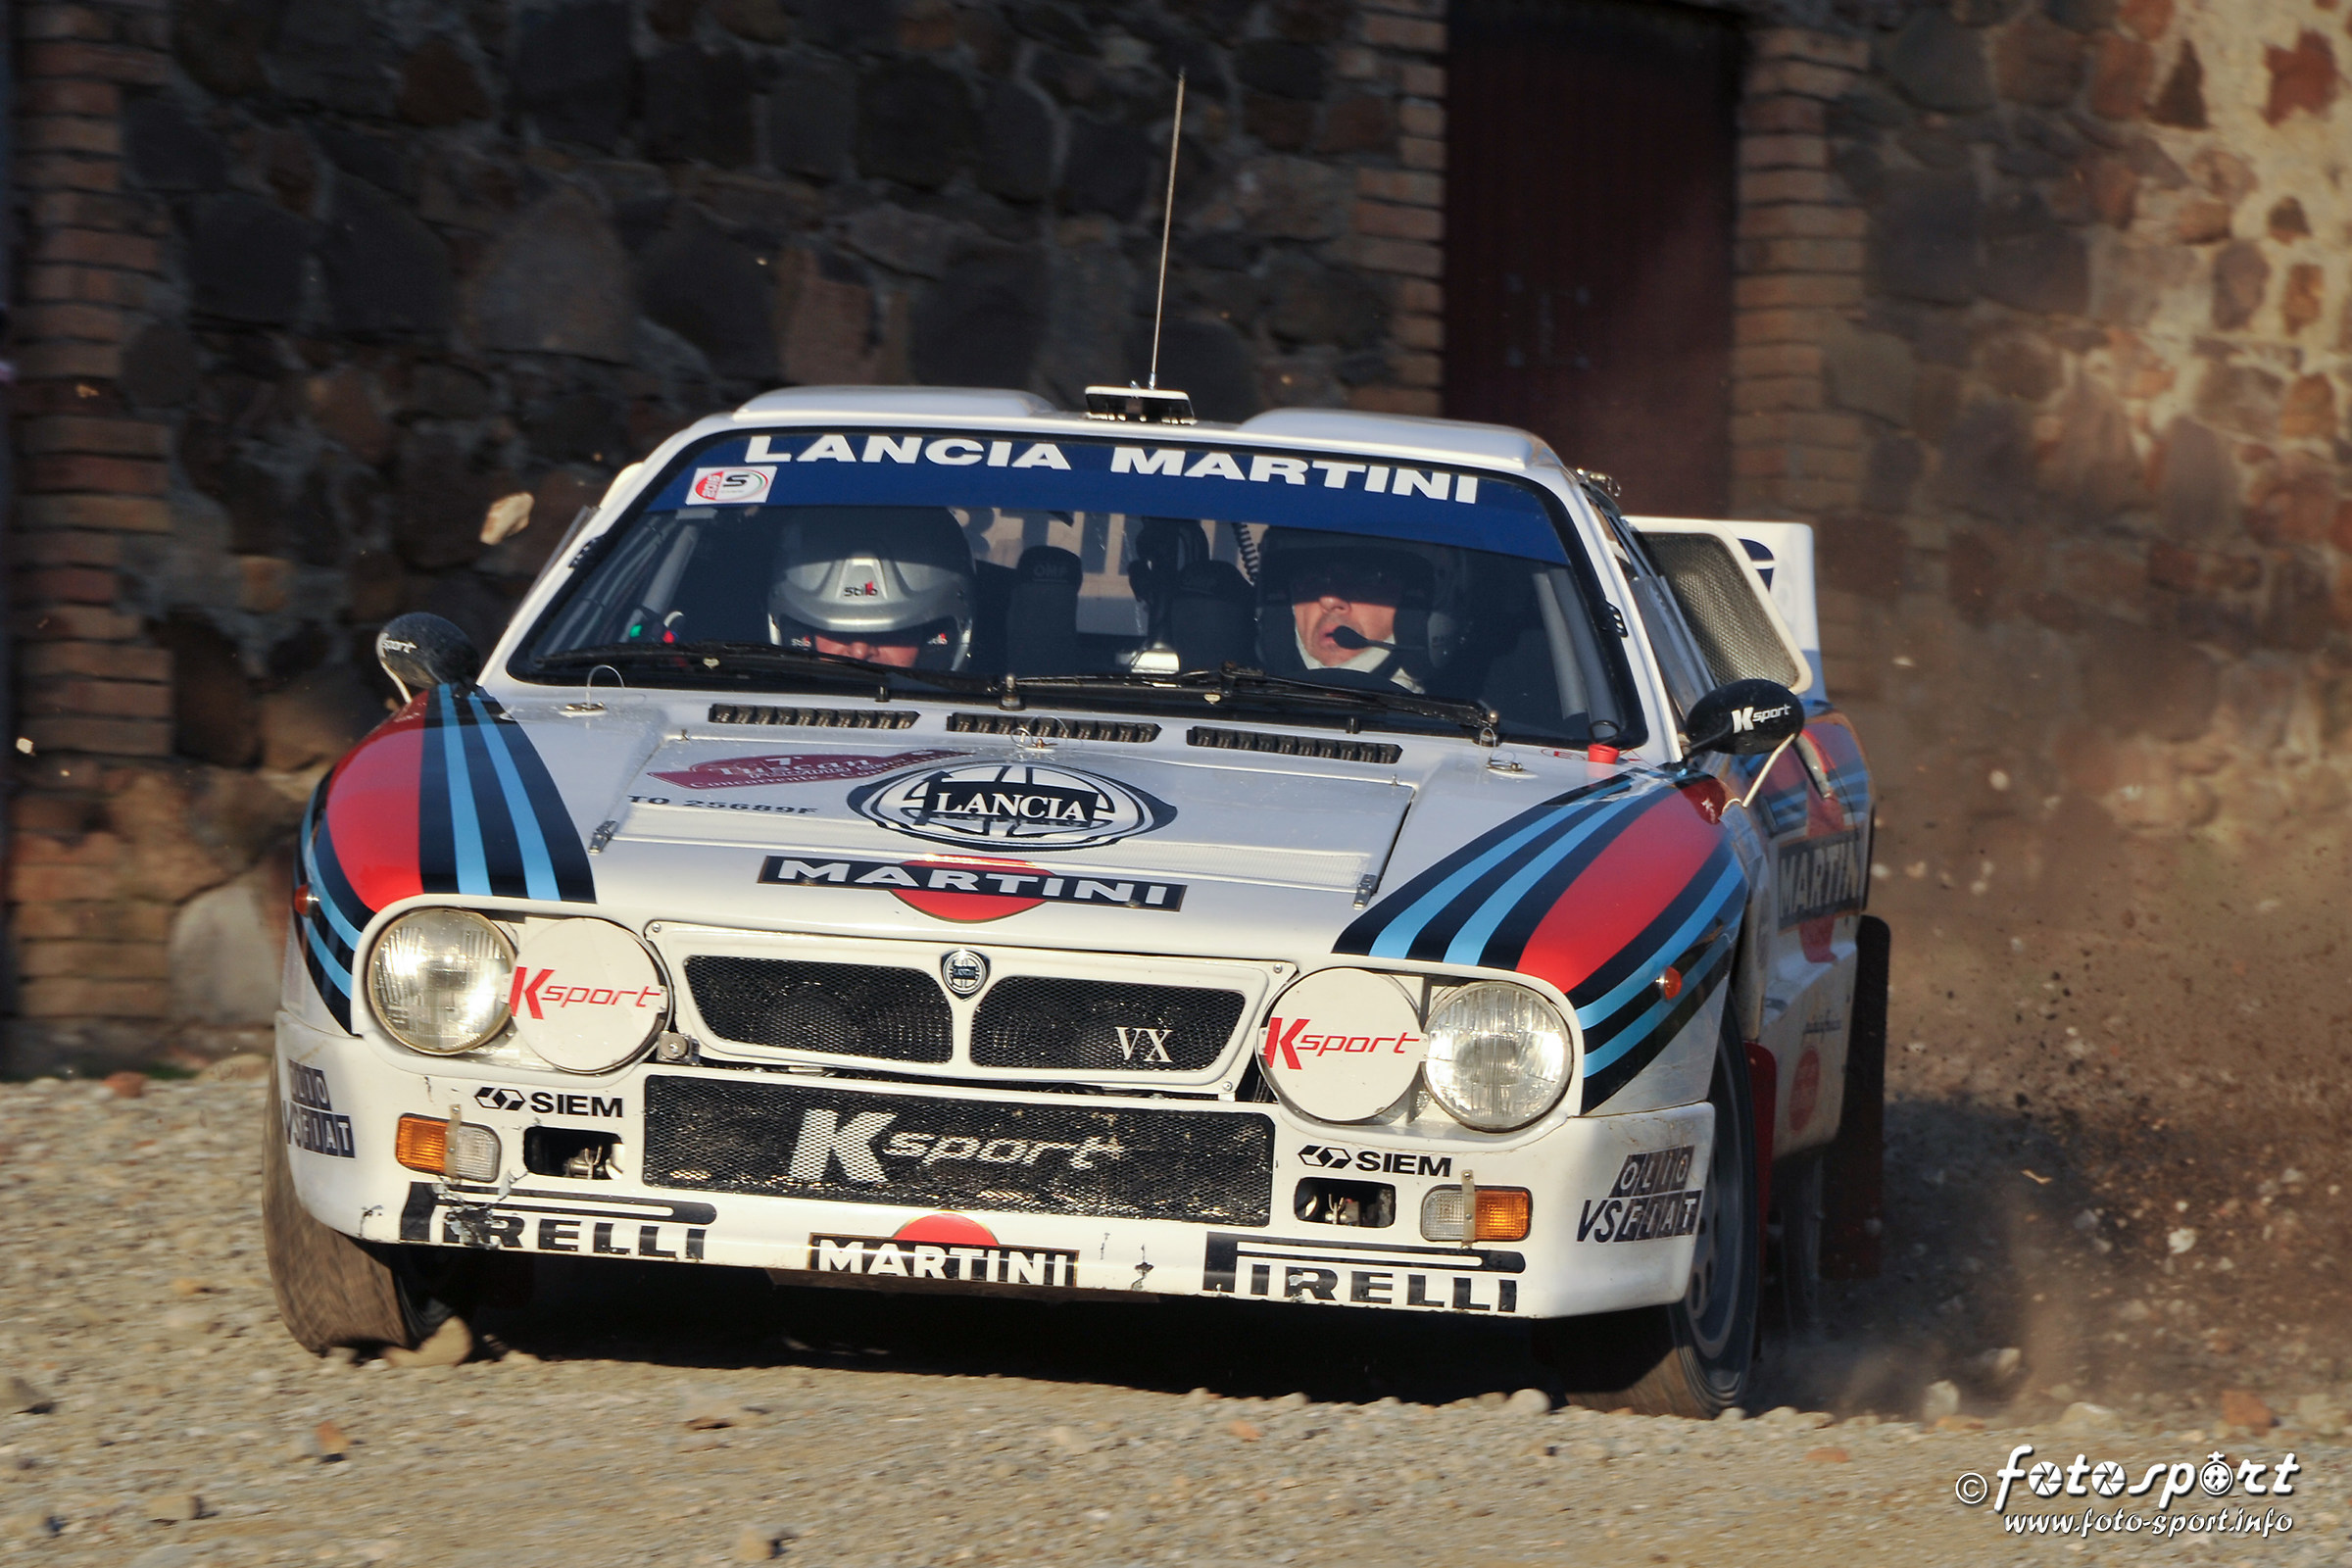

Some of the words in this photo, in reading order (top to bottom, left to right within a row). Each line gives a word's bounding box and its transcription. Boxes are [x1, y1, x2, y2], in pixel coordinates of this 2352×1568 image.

[744, 434, 1072, 470] LANCIA
[1108, 447, 1481, 506] MARTINI
[683, 799, 819, 814] 25689F
[932, 792, 1088, 823] LANCIA
[776, 858, 1167, 906] MARTINI
[1114, 1026, 1173, 1063] VX
[530, 1090, 624, 1118] SIEM
[1354, 1150, 1452, 1179] SIEM
[1619, 1152, 1690, 1191] OLIO
[399, 1181, 716, 1261] PIRELLI
[816, 1238, 1072, 1288] MARTINI
[1202, 1231, 1527, 1313] PIRELLI
